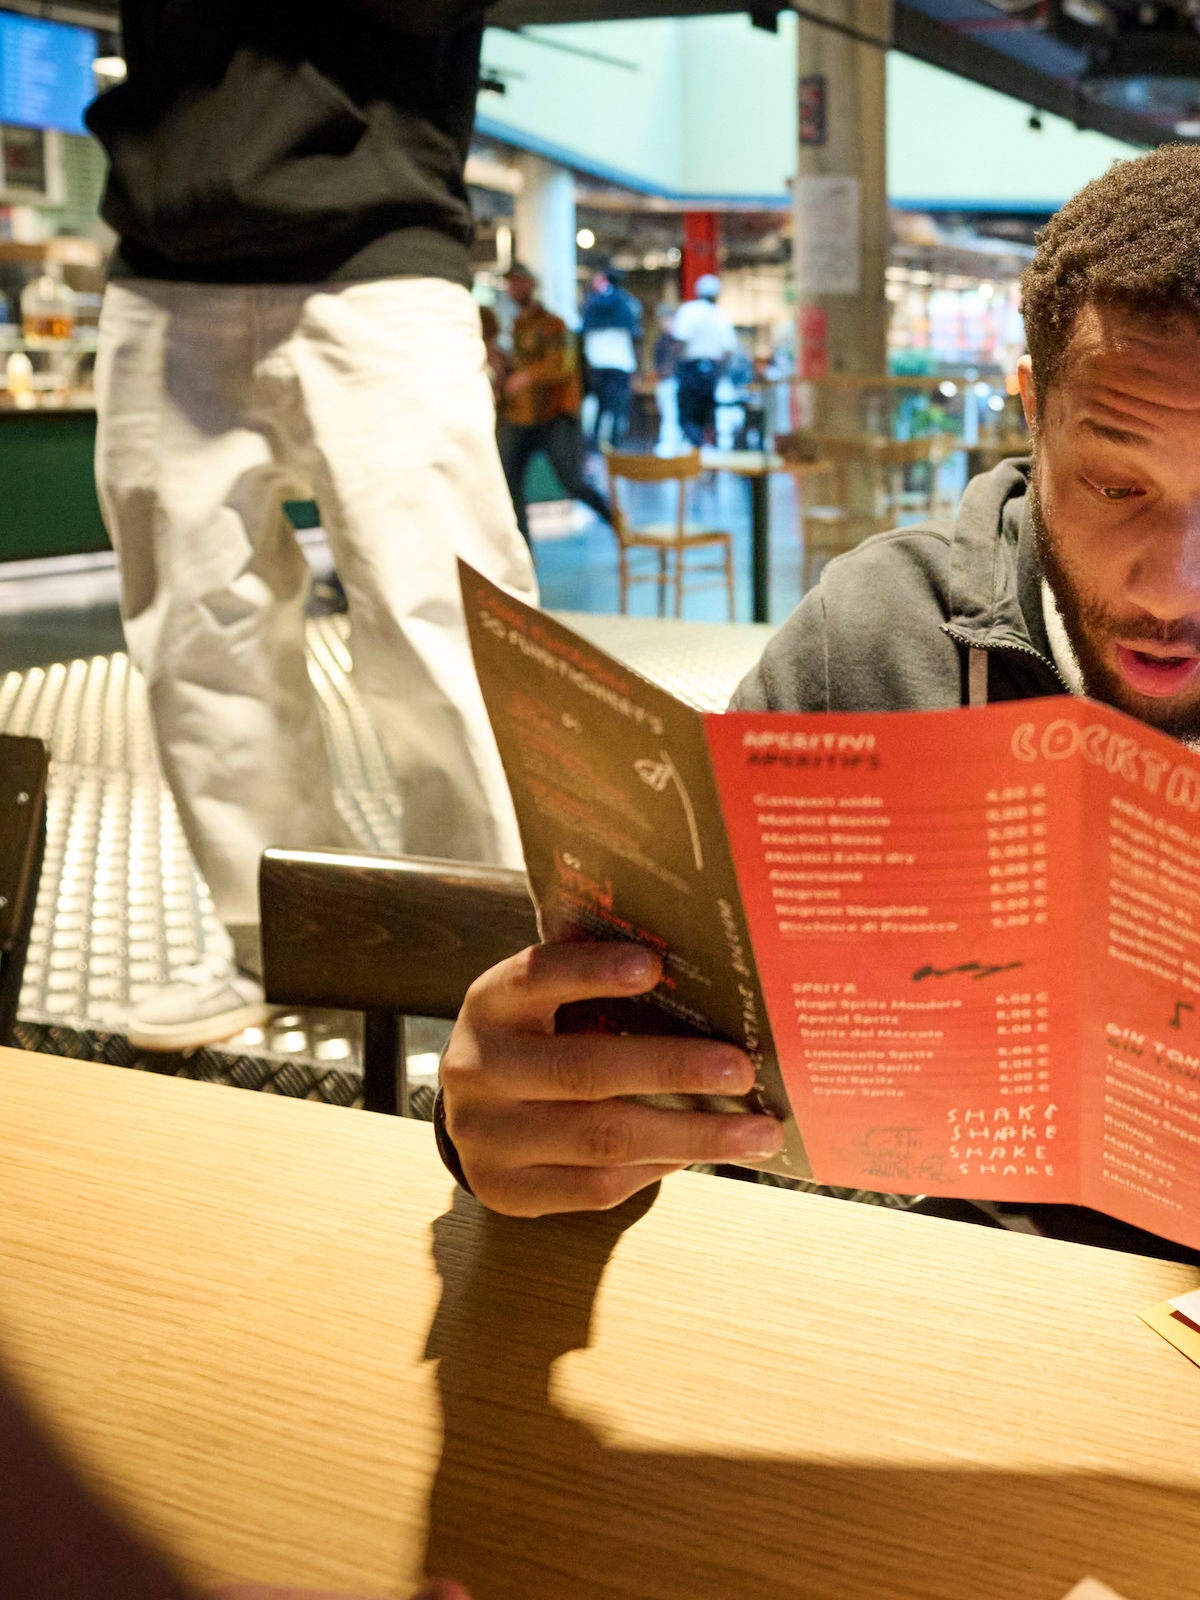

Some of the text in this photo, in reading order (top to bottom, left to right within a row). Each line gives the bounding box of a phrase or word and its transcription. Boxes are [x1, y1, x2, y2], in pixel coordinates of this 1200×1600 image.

[742, 731, 876, 749] APERITIVI
[1106, 1022, 1145, 1044] GIN
[947, 1103, 1058, 1123] SHAKE
[949, 1145, 1046, 1160] SHAKE
[958, 1163, 1054, 1176] SHAKE
